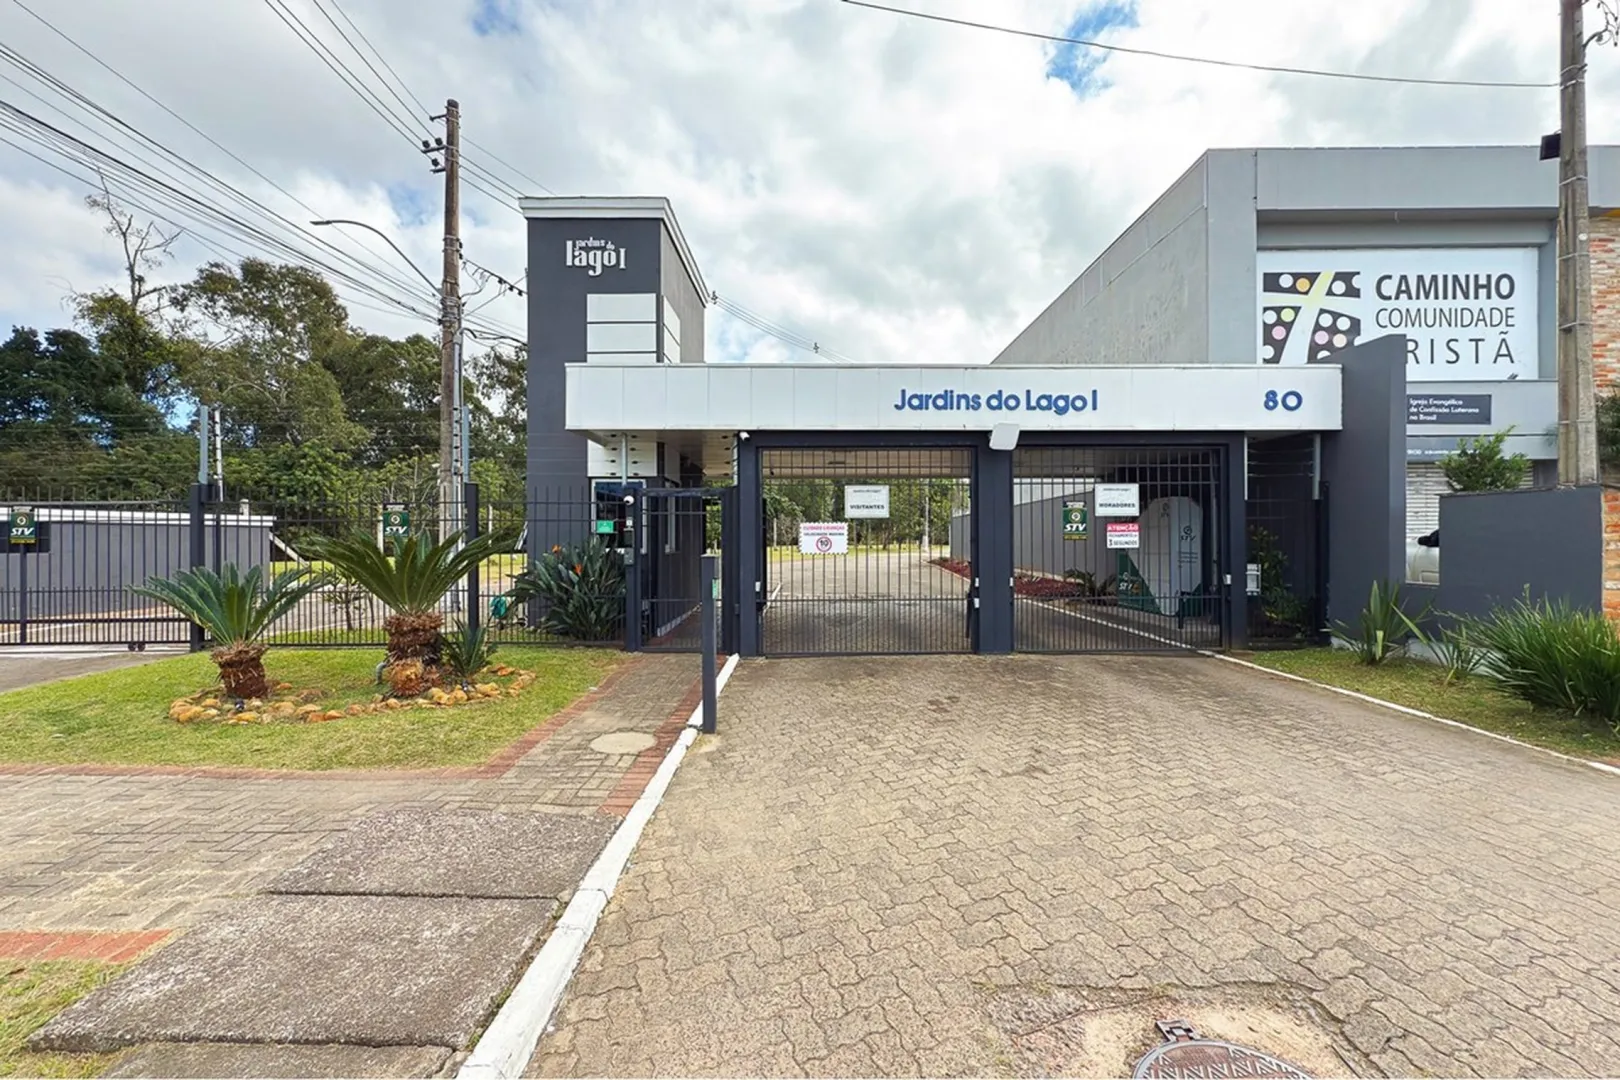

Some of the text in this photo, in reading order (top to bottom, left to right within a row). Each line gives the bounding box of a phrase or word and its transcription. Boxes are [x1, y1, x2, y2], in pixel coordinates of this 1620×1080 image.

[566, 240, 616, 276] lago
[1375, 273, 1515, 301] CAMINHO
[1375, 307, 1515, 328] COMUNIDADE
[1406, 331, 1515, 364] RISTÃ
[894, 389, 982, 411] Jardins
[986, 389, 1020, 411] do
[1026, 389, 1088, 415] Lago
[1263, 390, 1303, 411] 80
[1409, 398, 1428, 406] Igreja
[1419, 405, 1450, 413] Confissão
[11, 527, 35, 536] STV
[1064, 523, 1087, 531] STV
[1107, 523, 1139, 531] ATENÇÃO
[819, 539, 829, 547] 10
[1108, 539, 1113, 547] 3
